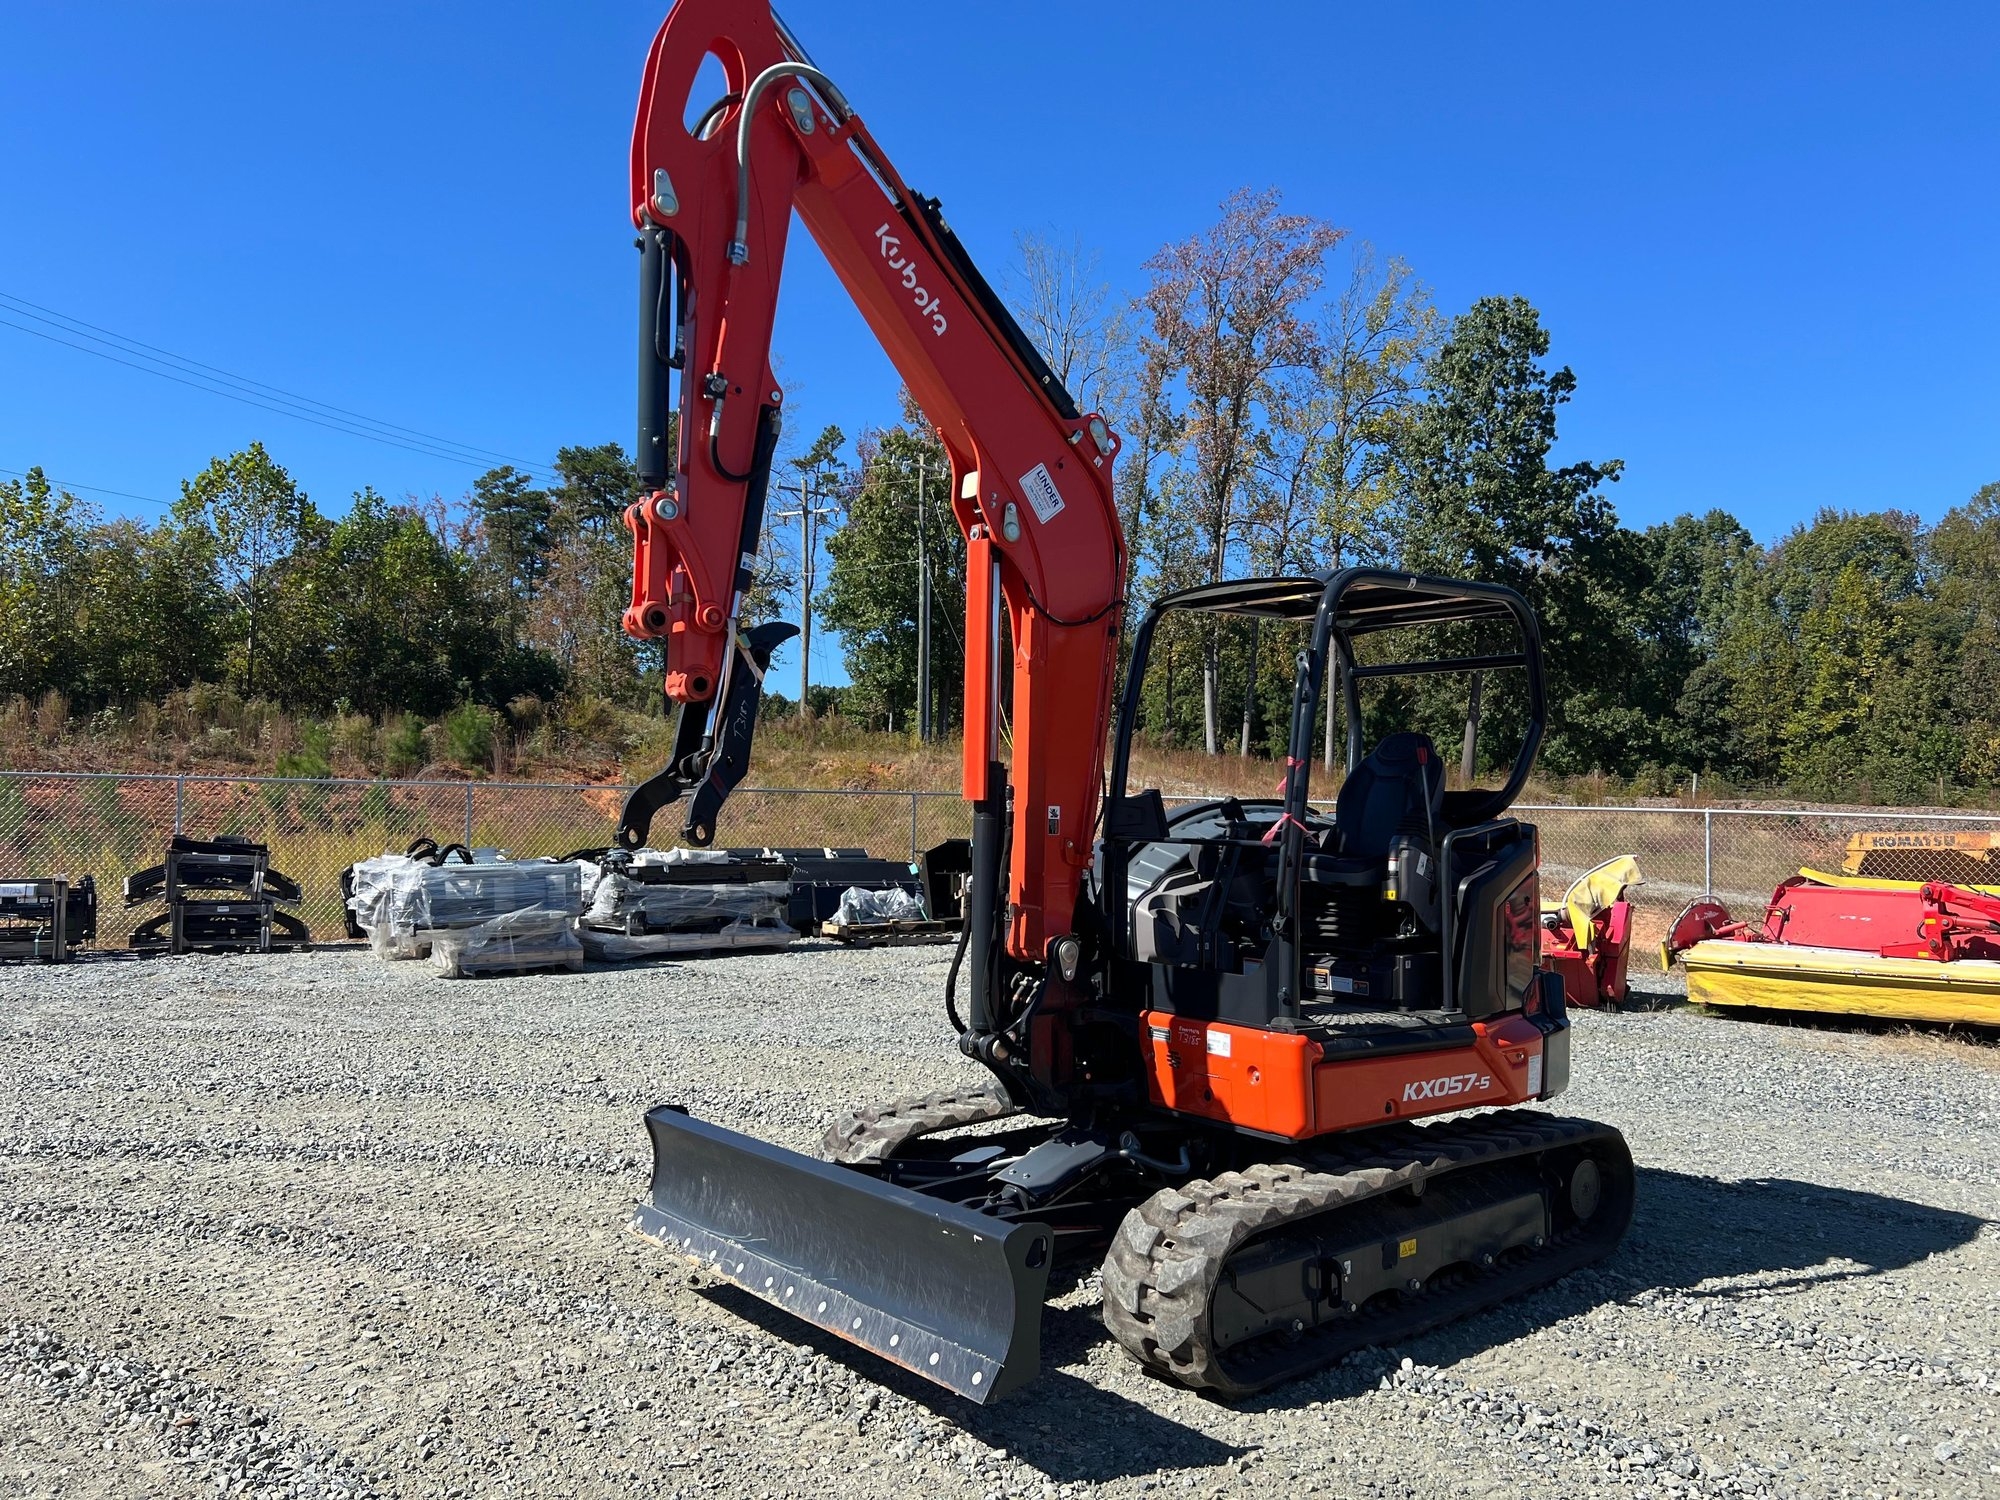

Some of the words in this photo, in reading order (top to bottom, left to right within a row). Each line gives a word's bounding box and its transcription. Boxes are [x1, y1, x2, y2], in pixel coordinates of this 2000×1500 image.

[875, 223, 947, 337] Kubota
[1036, 469, 1060, 508] LINDER
[1872, 835, 1956, 848] KOMATSU
[1402, 1073, 1490, 1102] KX057-5
